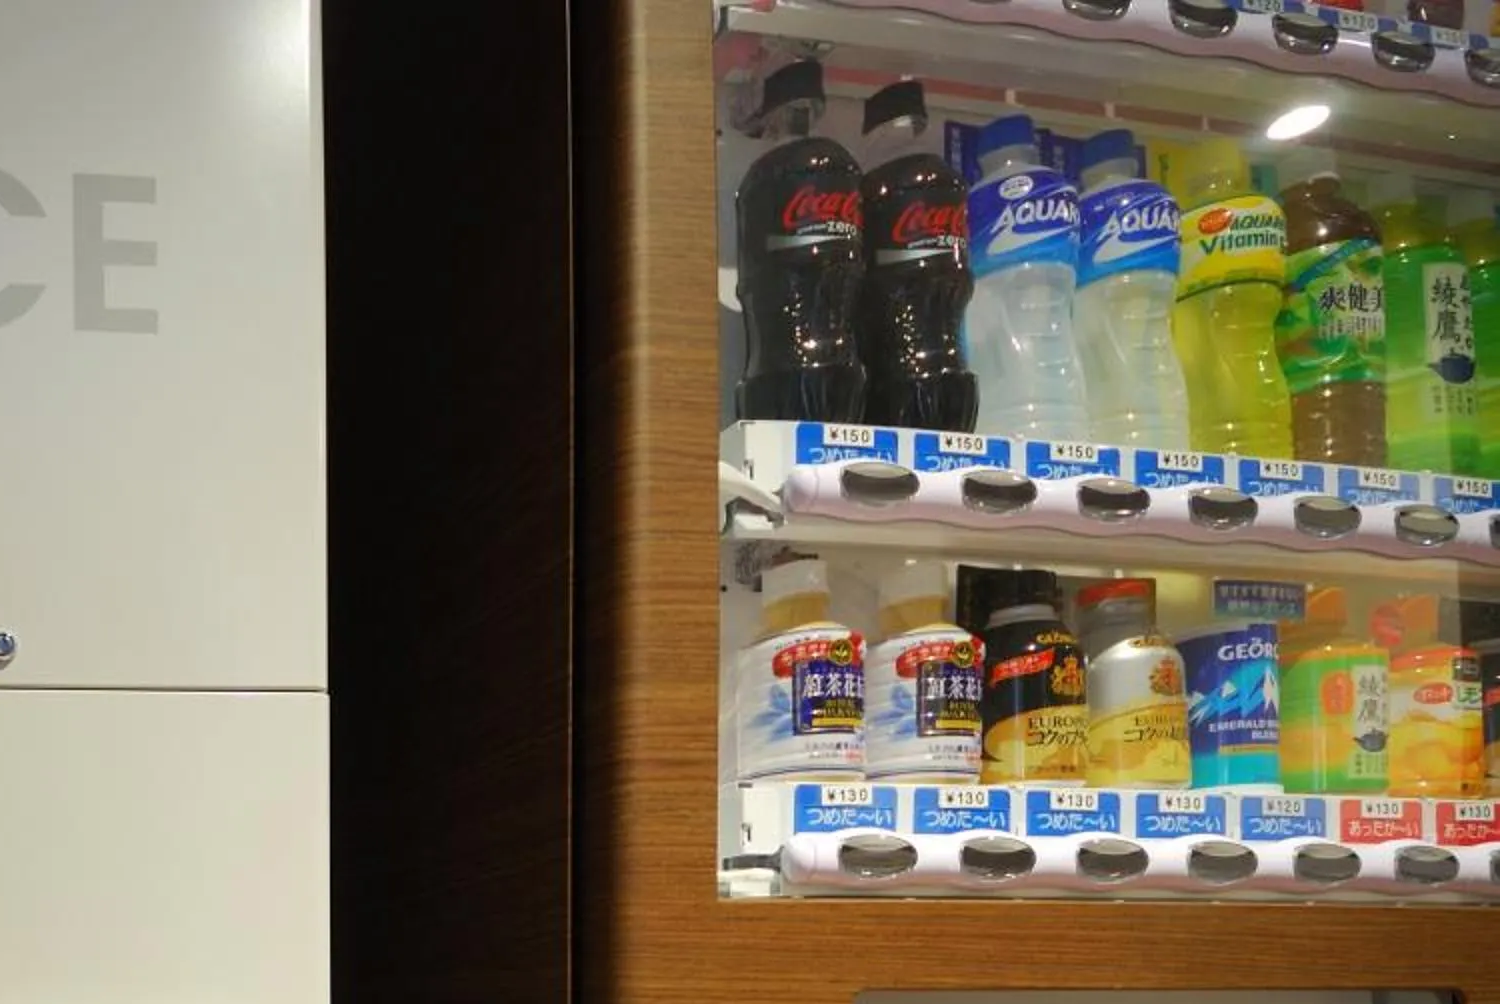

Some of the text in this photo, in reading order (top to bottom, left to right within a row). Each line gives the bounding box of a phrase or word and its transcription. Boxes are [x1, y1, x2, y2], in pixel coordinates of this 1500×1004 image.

[826, 787, 869, 802] ¥130
[946, 790, 985, 805] ¥130
[1056, 793, 1094, 807] ¥130
[1165, 796, 1201, 810] ¥130
[1267, 801, 1301, 814] ¥120
